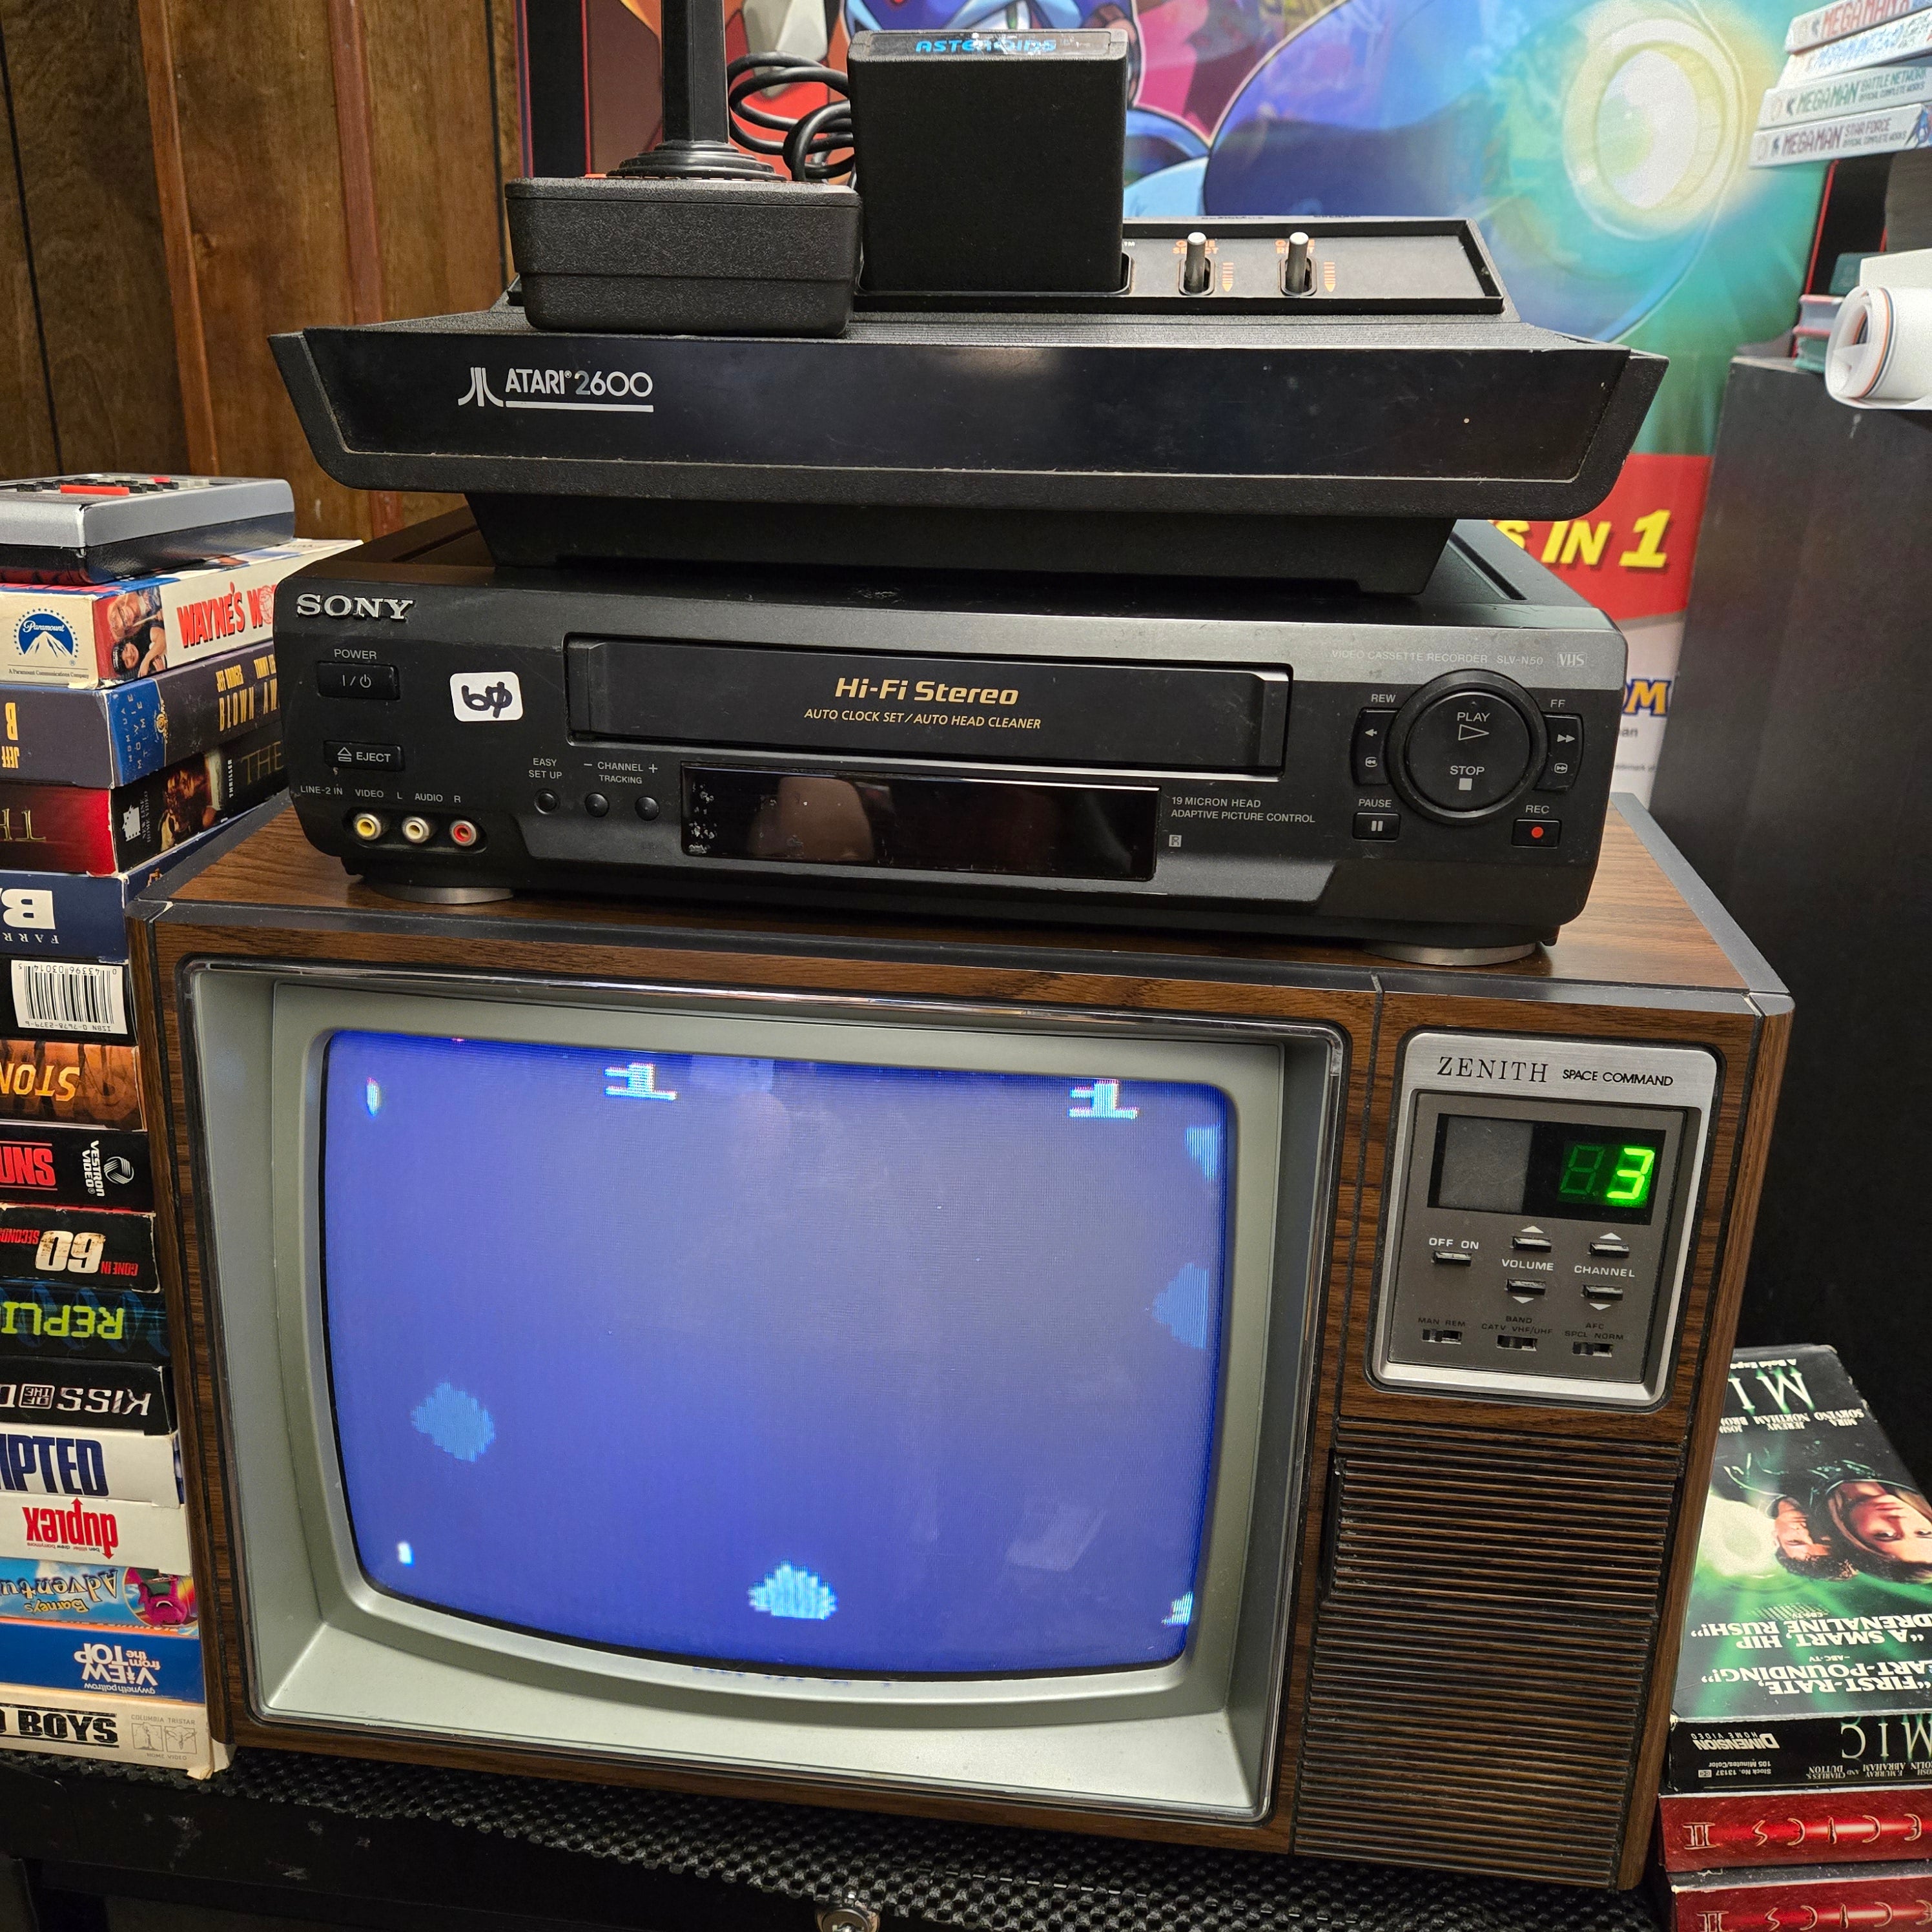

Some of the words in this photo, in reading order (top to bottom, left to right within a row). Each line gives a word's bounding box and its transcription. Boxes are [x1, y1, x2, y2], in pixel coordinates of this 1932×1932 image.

[574, 371, 653, 398] 2600
[1541, 520, 1612, 566] IN
[1618, 509, 1672, 568] 1
[296, 593, 414, 621] SONY
[176, 581, 245, 649] WAYNE'S
[22, 620, 65, 633] Paramount
[333, 648, 377, 661] POWER
[1331, 649, 1364, 659] VIDEO
[1367, 651, 1423, 662] CASSETTE
[1426, 653, 1488, 663] RECORDER
[1497, 655, 1543, 665] SLV-N50
[1558, 652, 1585, 667] VHS
[834, 677, 909, 701] Hi-Fi
[913, 680, 1020, 705] Stereo
[1371, 694, 1396, 703] REW
[1550, 699, 1566, 708] FF
[218, 686, 254, 732] BLOWN
[804, 708, 839, 721] AUTO
[841, 710, 881, 723] CLOCK
[883, 712, 905, 723] SET
[913, 714, 949, 725] AUTO
[951, 715, 985, 728] HEAD
[987, 716, 1042, 730] CLEANER
[1457, 712, 1491, 723] PLAY
[127, 693, 143, 770] MOVIE
[136, 701, 149, 757] TIME
[240, 740, 285, 786] THE
[356, 751, 391, 763] EJECT
[533, 757, 557, 767] EASY
[597, 761, 644, 773] CHANNEL
[1450, 765, 1485, 776] STOP
[528, 769, 548, 779] SET
[549, 770, 562, 780] UP
[599, 774, 643, 785] TRACKING
[300, 785, 331, 796] LINE-2
[333, 786, 343, 796] IN
[355, 788, 384, 799] VIDEO
[396, 792, 403, 800] L
[415, 792, 444, 803] AUDIO
[454, 795, 462, 803] R
[1171, 796, 1183, 805] 19
[1184, 797, 1228, 807] MICRON
[1231, 799, 1261, 808] HEAD
[1358, 798, 1392, 808] PAUSE
[1171, 809, 1219, 819] ADAPTIVE
[1221, 811, 1264, 821] PICTURE
[1266, 813, 1316, 823] CONTROL
[1525, 805, 1550, 815] REC
[2, 932, 60, 945] FARR
[34, 965, 63, 974] 03014
[69, 967, 100, 975] 43396
[25, 1020, 88, 1031] 0-7678-2379-6
[1437, 1056, 1548, 1083] ZENITH
[1562, 1069, 1598, 1081] SPACE
[1603, 1071, 1674, 1087] COMMAND
[81, 1149, 95, 1188] VIDEO
[90, 1140, 105, 1197] VESTRON
[1606, 1147, 1656, 1200] 3
[1428, 1237, 1454, 1248] OFF
[1461, 1240, 1479, 1250] ON
[35, 1230, 107, 1273] 60
[101, 1261, 112, 1274] IN
[112, 1261, 139, 1277] GONE
[1501, 1259, 1554, 1271] VOLUME
[1574, 1265, 1636, 1277] CHANNEL
[1, 1301, 125, 1340] REPLI
[1417, 1317, 1441, 1326] MAN
[1444, 1319, 1466, 1328] REM
[1505, 1315, 1532, 1324] BAND
[1481, 1323, 1506, 1331] CATV
[1512, 1326, 1553, 1335] VHF/UHF
[1564, 1330, 1588, 1339] SPCL
[1594, 1332, 1624, 1341] NORM
[24, 1387, 51, 1398] THE
[24, 1396, 50, 1405] OF
[56, 1387, 152, 1416] KISS
[1813, 1408, 1865, 1421] SORVINO
[1828, 1417, 1858, 1427] MIRA
[22, 1497, 119, 1559] duplex
[1783, 1613, 1932, 1634] DRENALINE
[1736, 1634, 1783, 1649] HIP
[1785, 1630, 1886, 1647] SMART,
[73, 1643, 128, 1667] TOP
[125, 1650, 147, 1660] the
[128, 1659, 161, 1670] from
[84, 1682, 118, 1692] paltrow
[118, 1685, 156, 1695] gwyneth
[131, 1714, 165, 1723] COLUMBIA
[168, 1717, 196, 1725] TRISTAR
[17, 1710, 118, 1745] BOYS
[1692, 1733, 1780, 1751] DIMENSION
[1809, 1765, 1843, 1774] DUTTON
[1863, 1762, 1906, 1772] ABRAHAM
